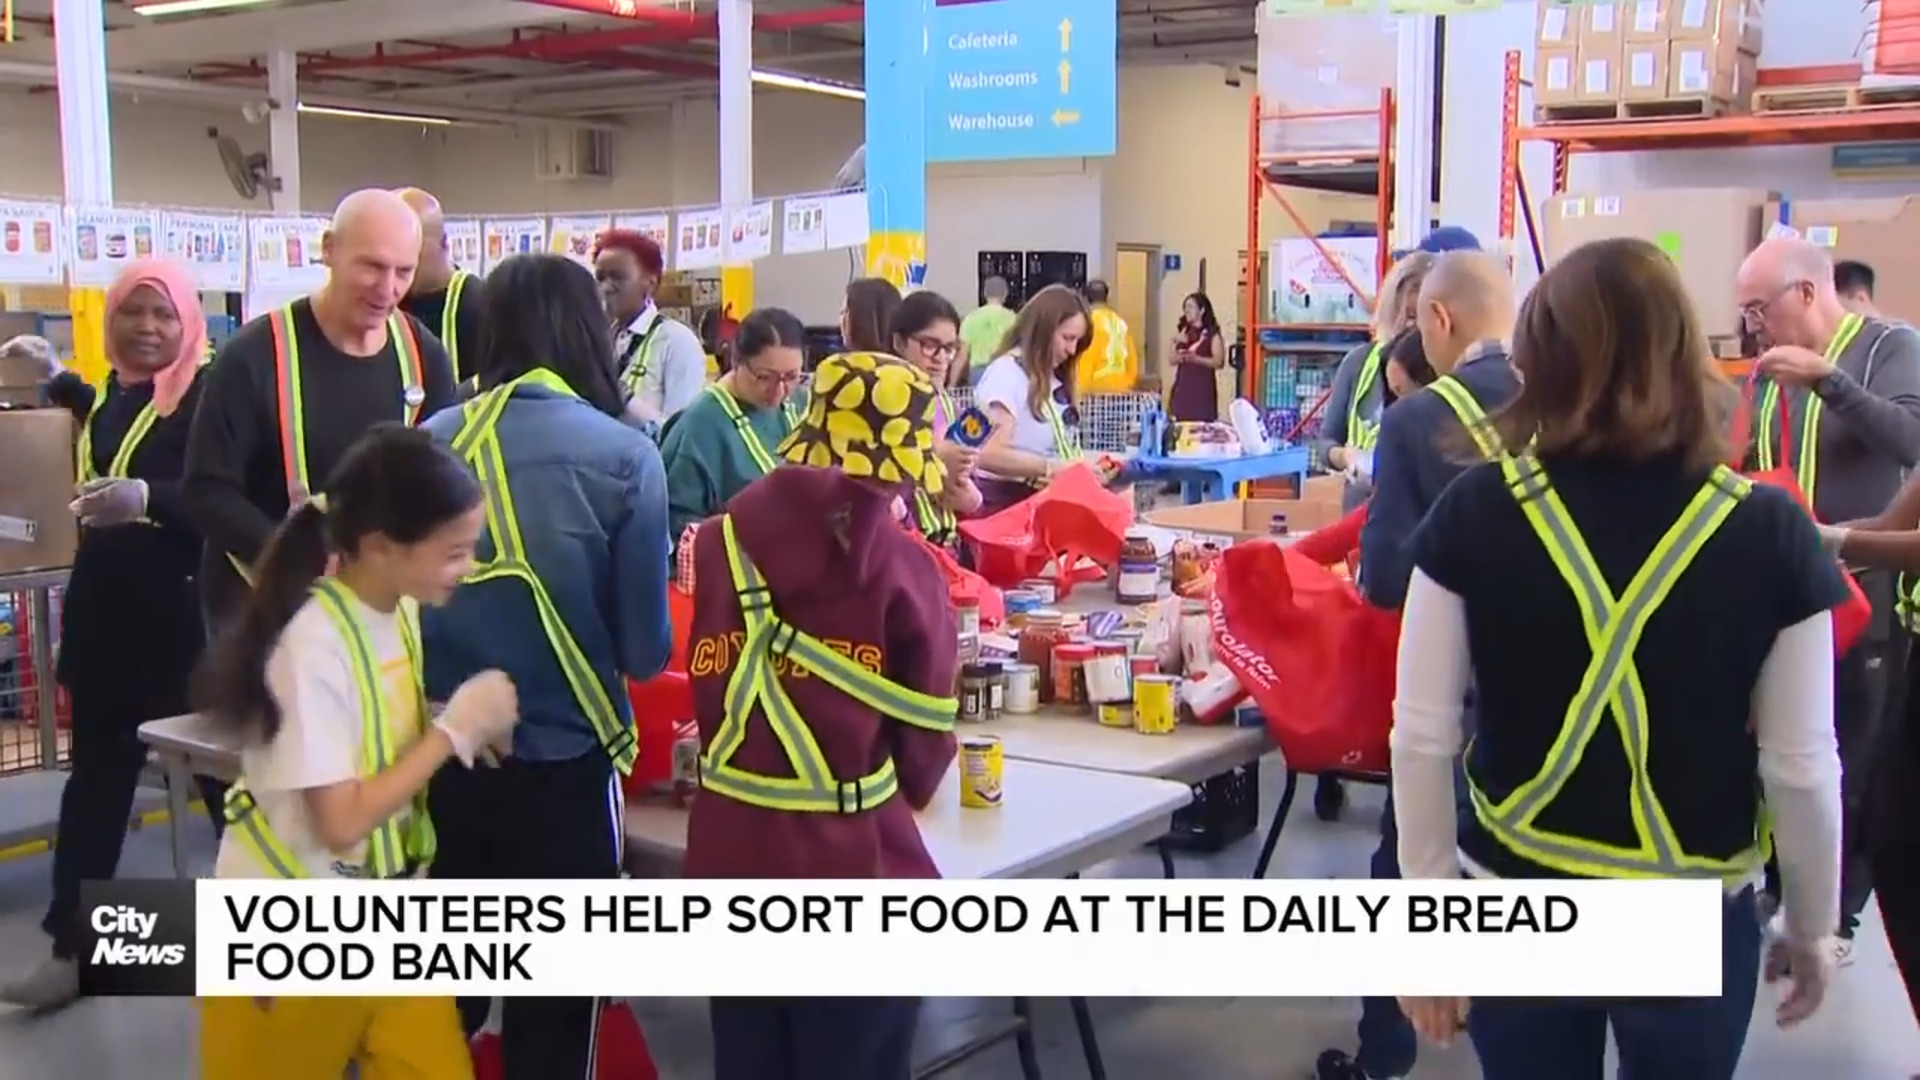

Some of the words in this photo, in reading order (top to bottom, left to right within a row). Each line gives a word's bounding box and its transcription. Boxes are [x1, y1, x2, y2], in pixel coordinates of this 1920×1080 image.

[948, 31, 1018, 49] Cafeteria
[948, 71, 1038, 88] Washrooms
[948, 112, 1034, 130] Warehouse
[77, 214, 114, 225] PEANUT
[116, 216, 152, 225] BUTTER
